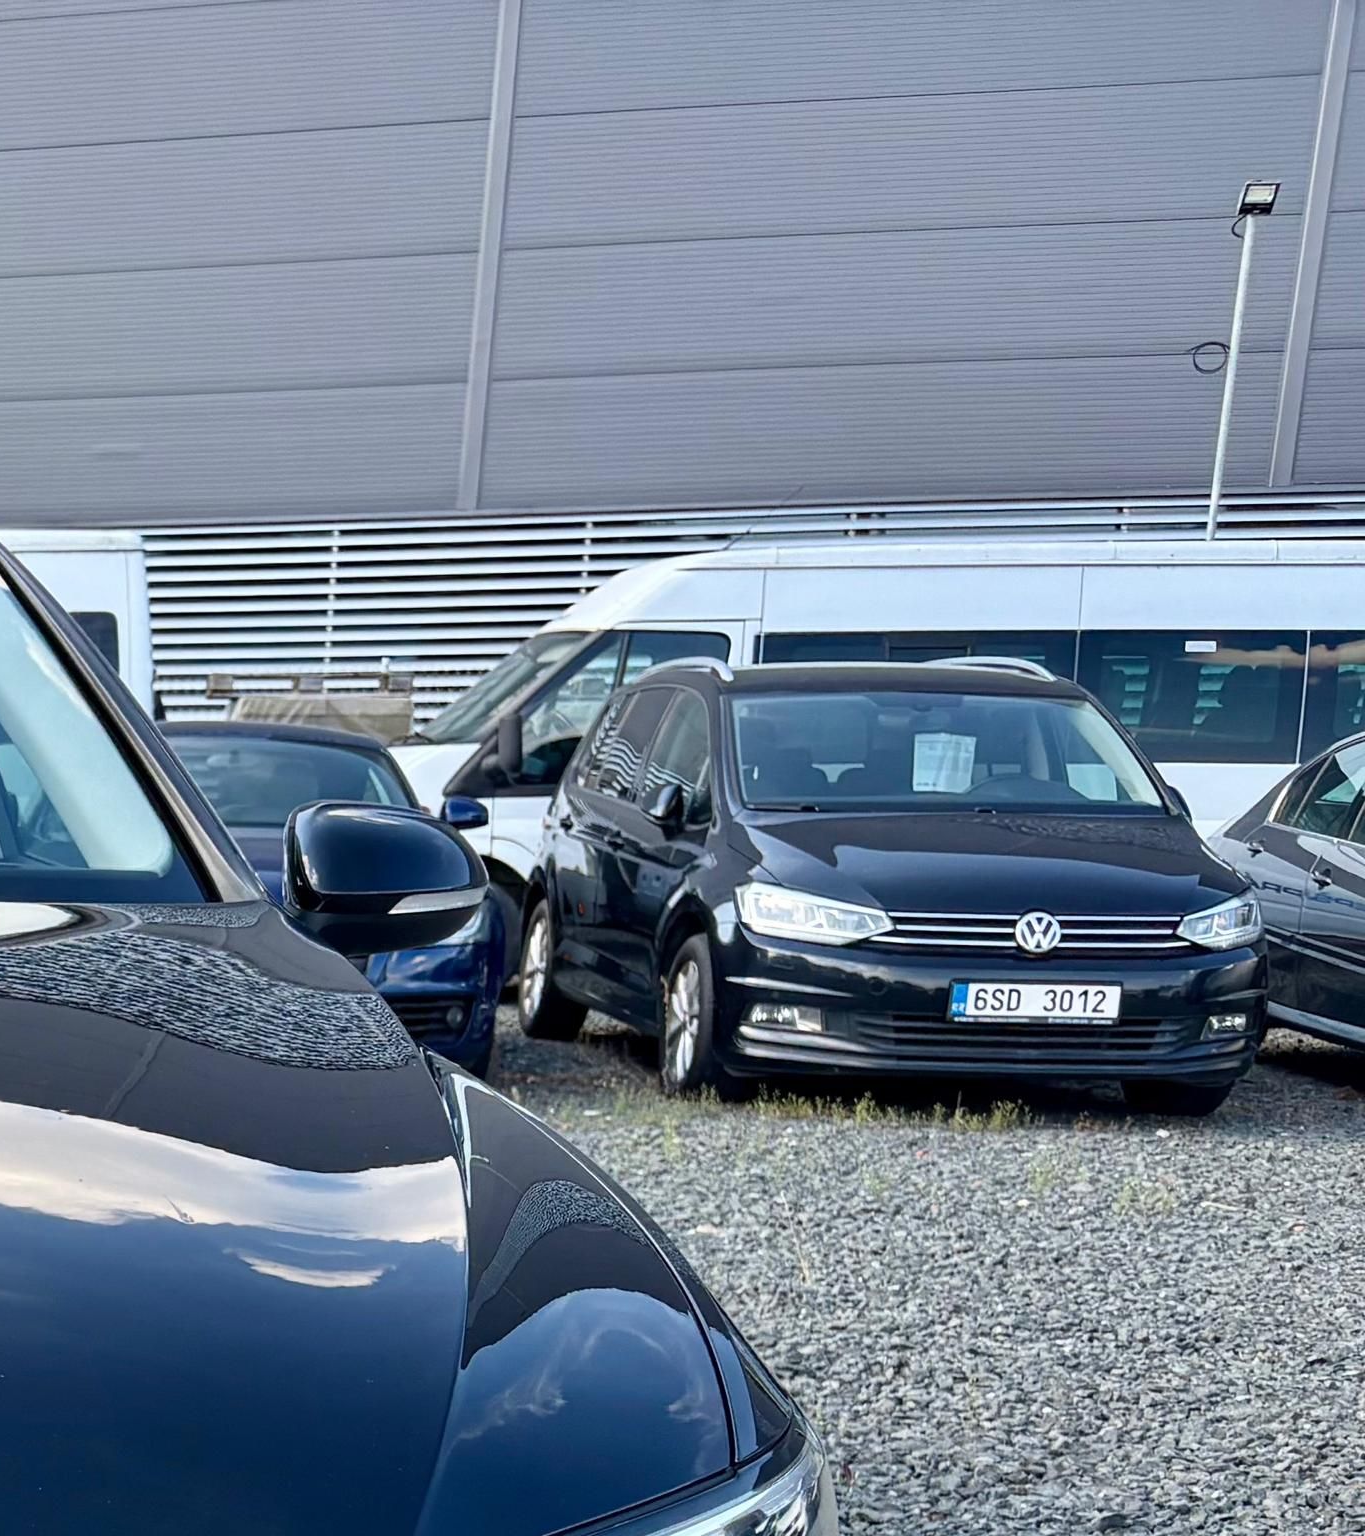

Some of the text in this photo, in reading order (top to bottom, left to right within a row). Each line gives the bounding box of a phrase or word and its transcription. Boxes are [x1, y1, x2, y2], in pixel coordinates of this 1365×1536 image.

[1017, 913, 1059, 950] VW
[974, 988, 1107, 1013] 6SD 3012
